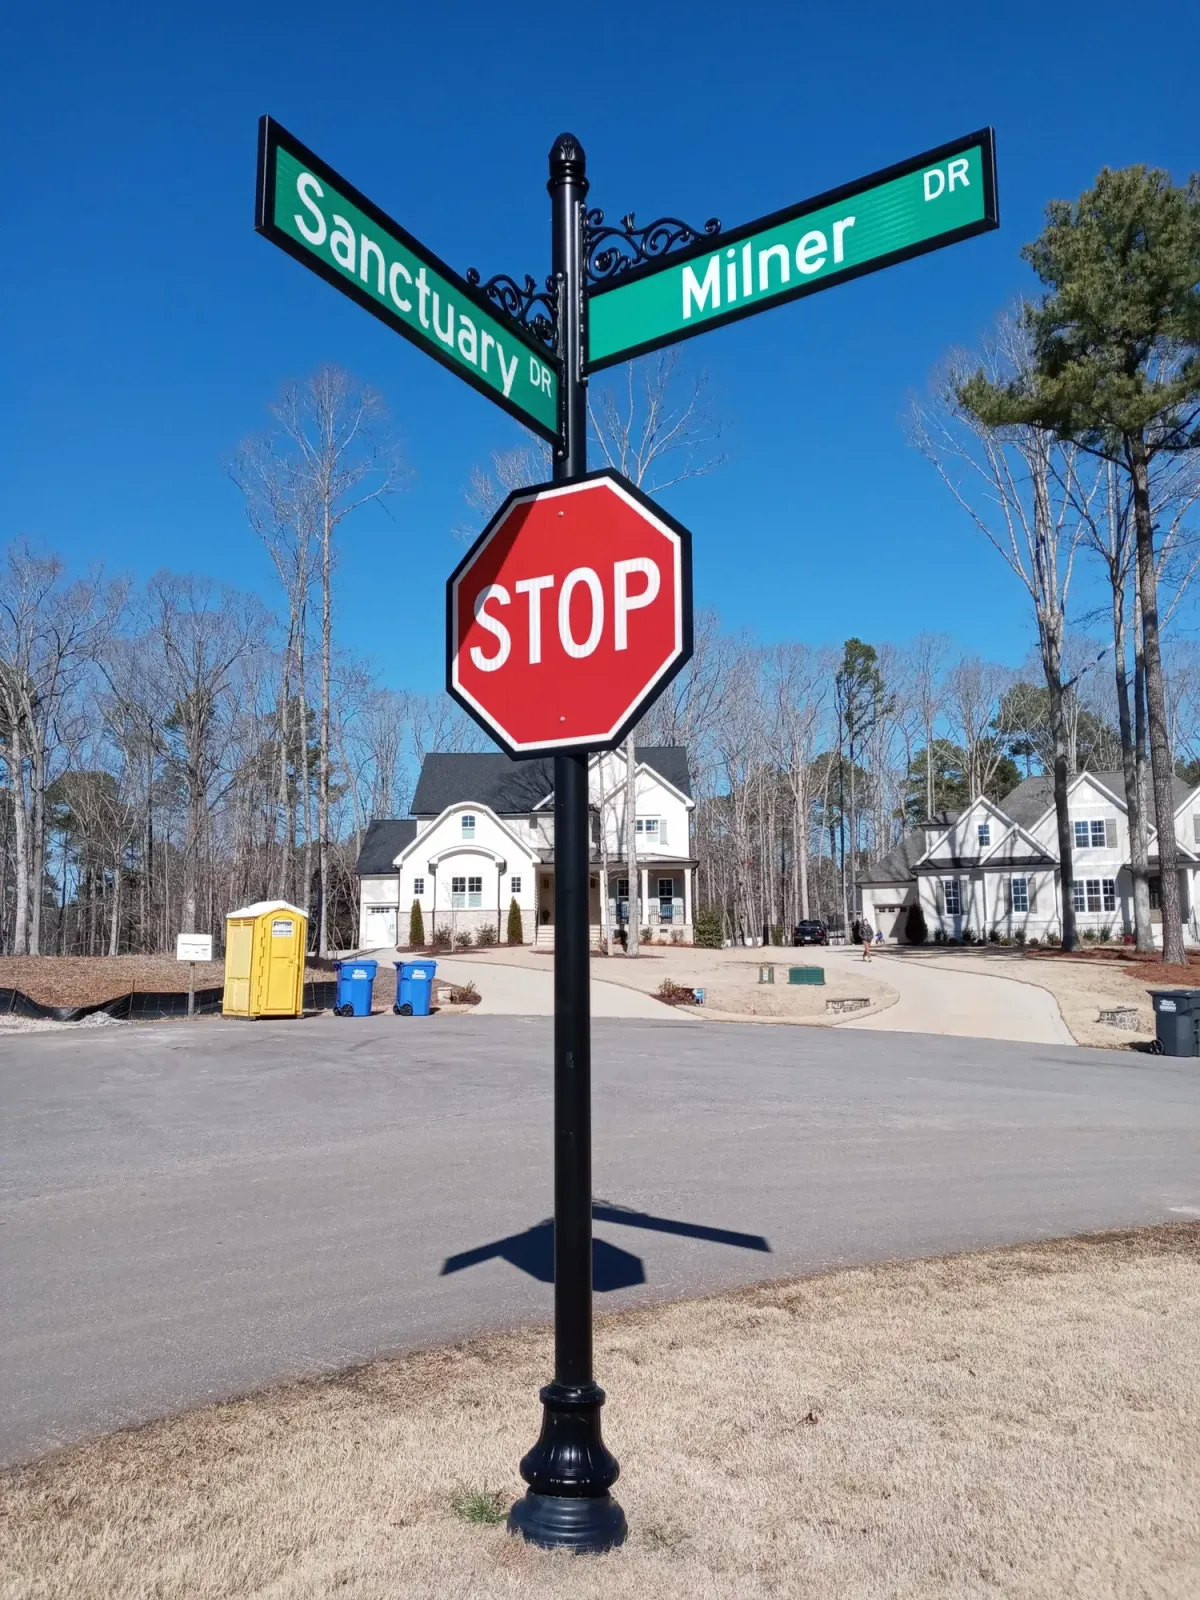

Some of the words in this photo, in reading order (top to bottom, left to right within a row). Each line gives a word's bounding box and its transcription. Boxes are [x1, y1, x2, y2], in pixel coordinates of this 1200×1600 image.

[294, 172, 518, 397] Sanctuary
[529, 356, 552, 398] DR
[682, 215, 856, 319] Milner
[923, 158, 970, 201] DR
[470, 557, 660, 672] STOP
